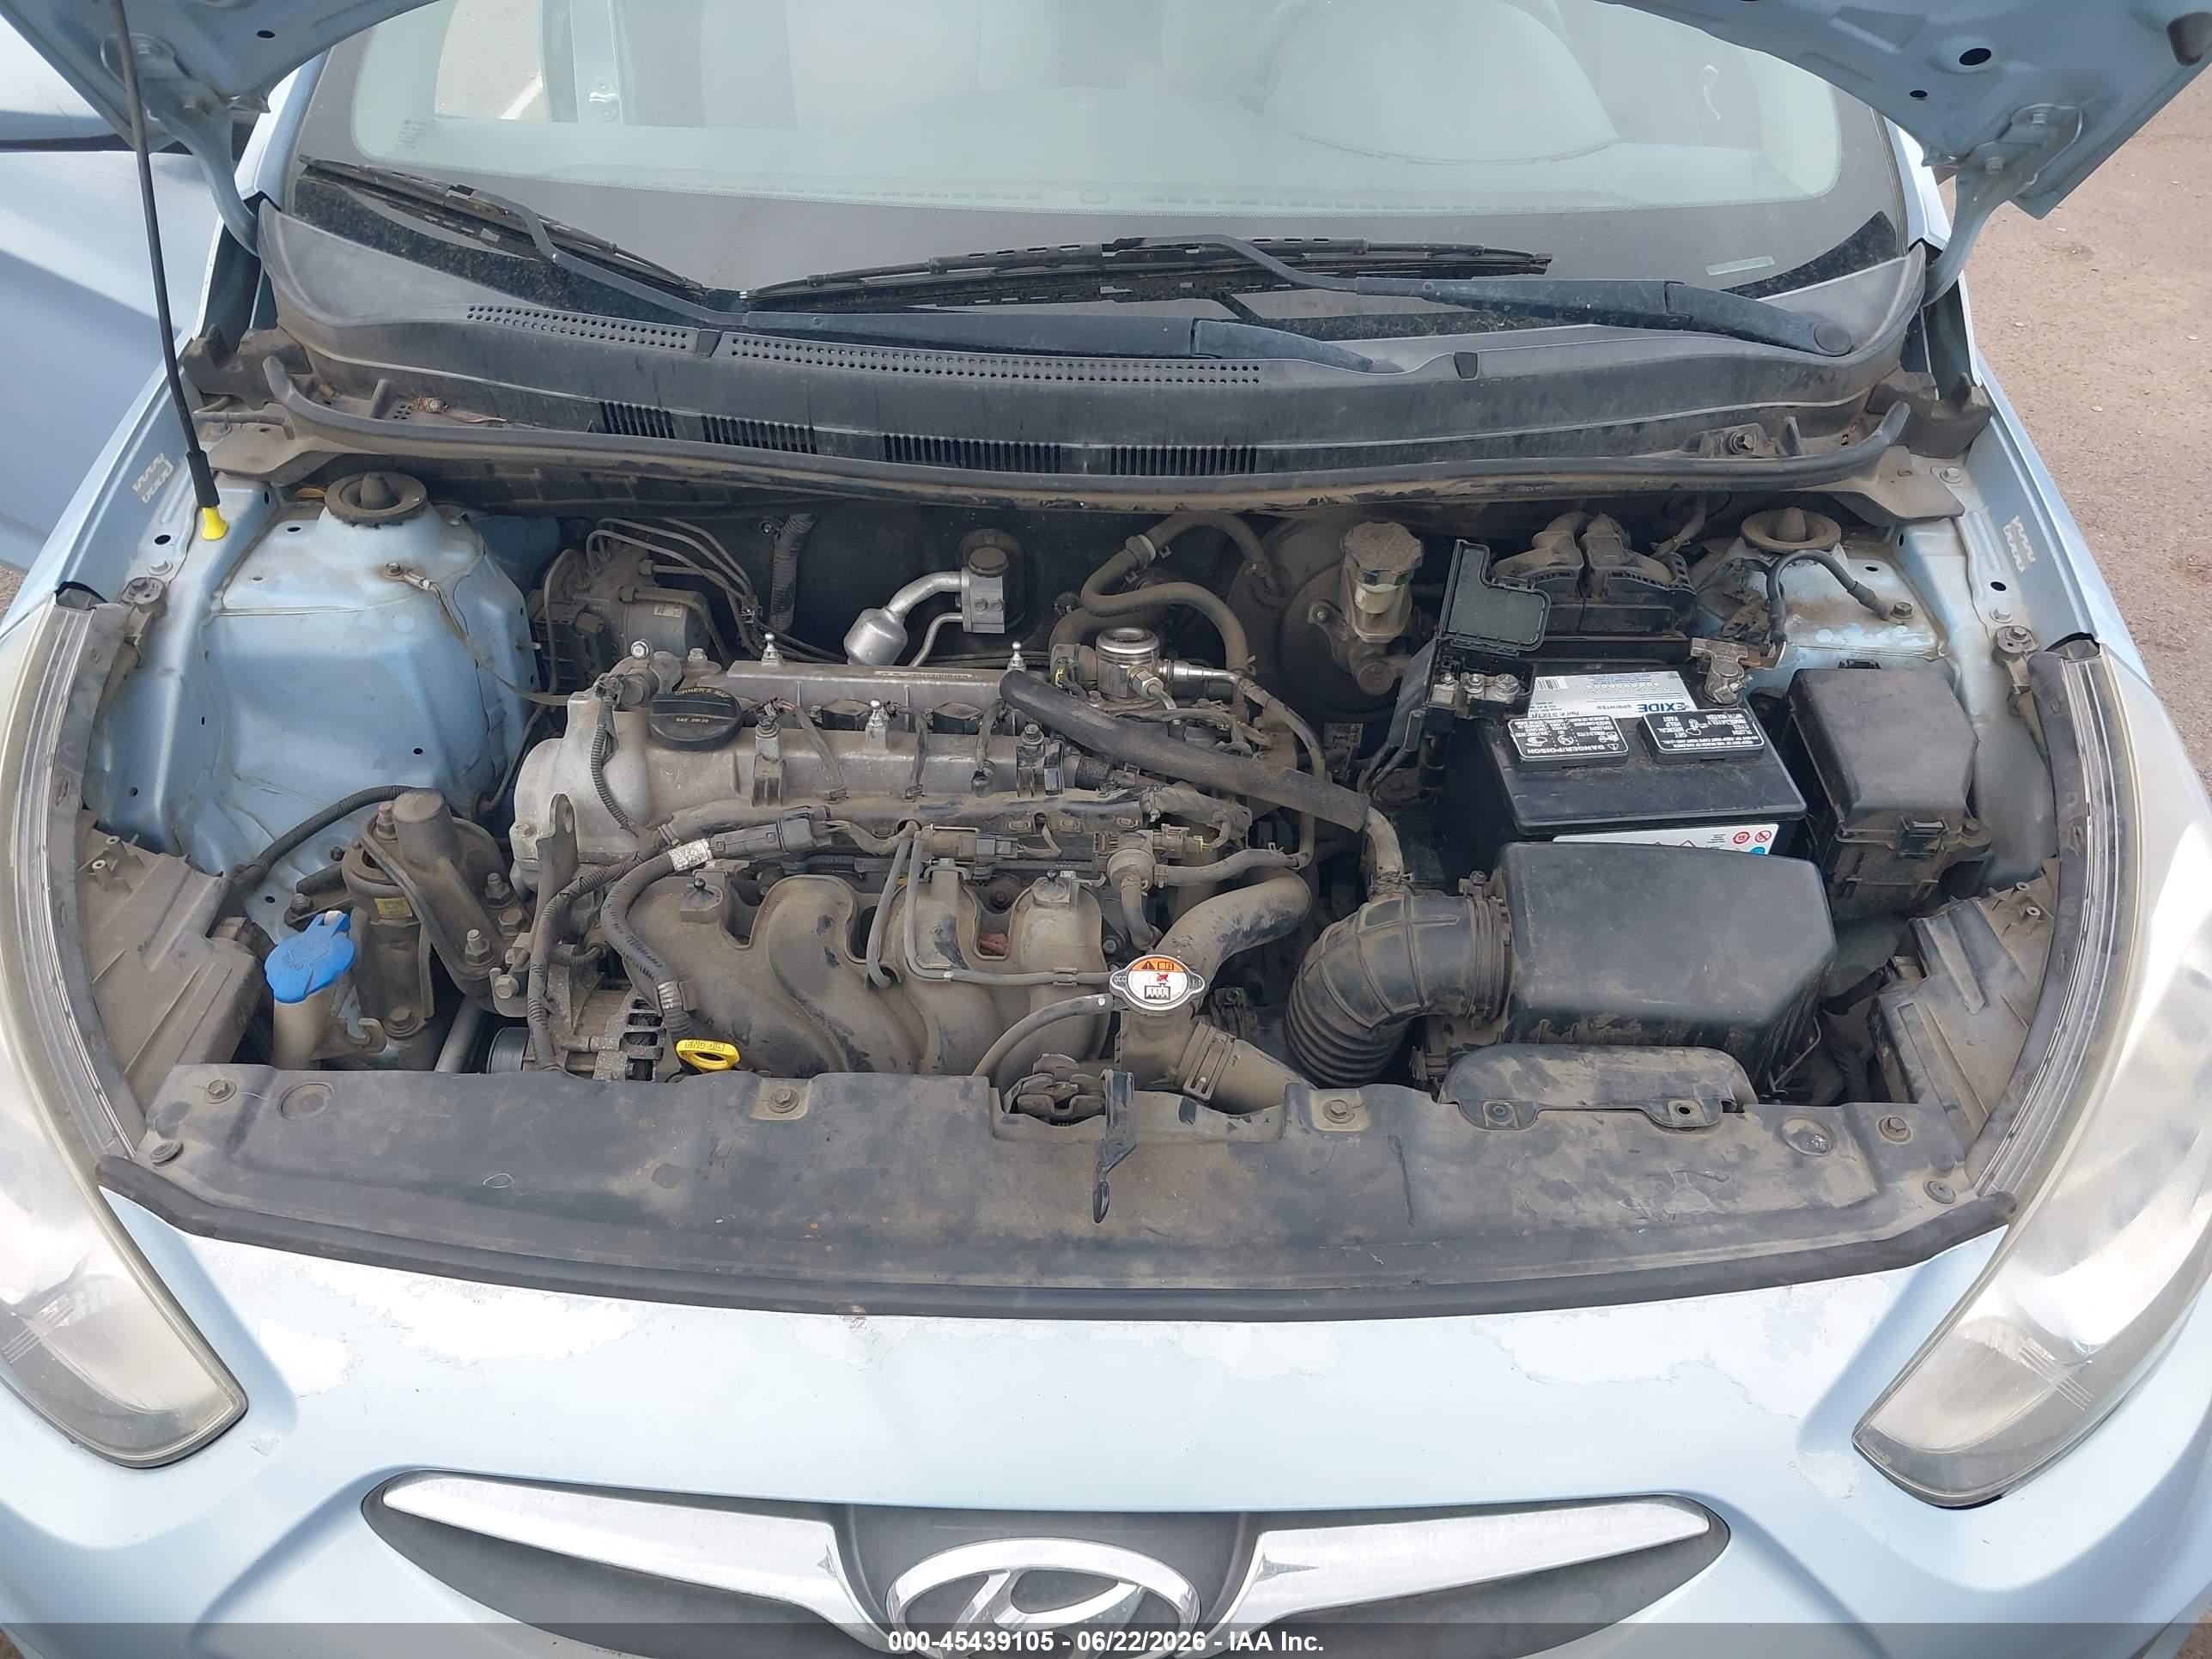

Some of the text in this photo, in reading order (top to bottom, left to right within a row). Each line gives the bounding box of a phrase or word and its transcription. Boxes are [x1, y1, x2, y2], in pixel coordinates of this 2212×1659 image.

[1636, 702, 1686, 712] EXIDE
[1527, 744, 1605, 754] DANGER/POISON
[685, 1041, 705, 1050] ENG
